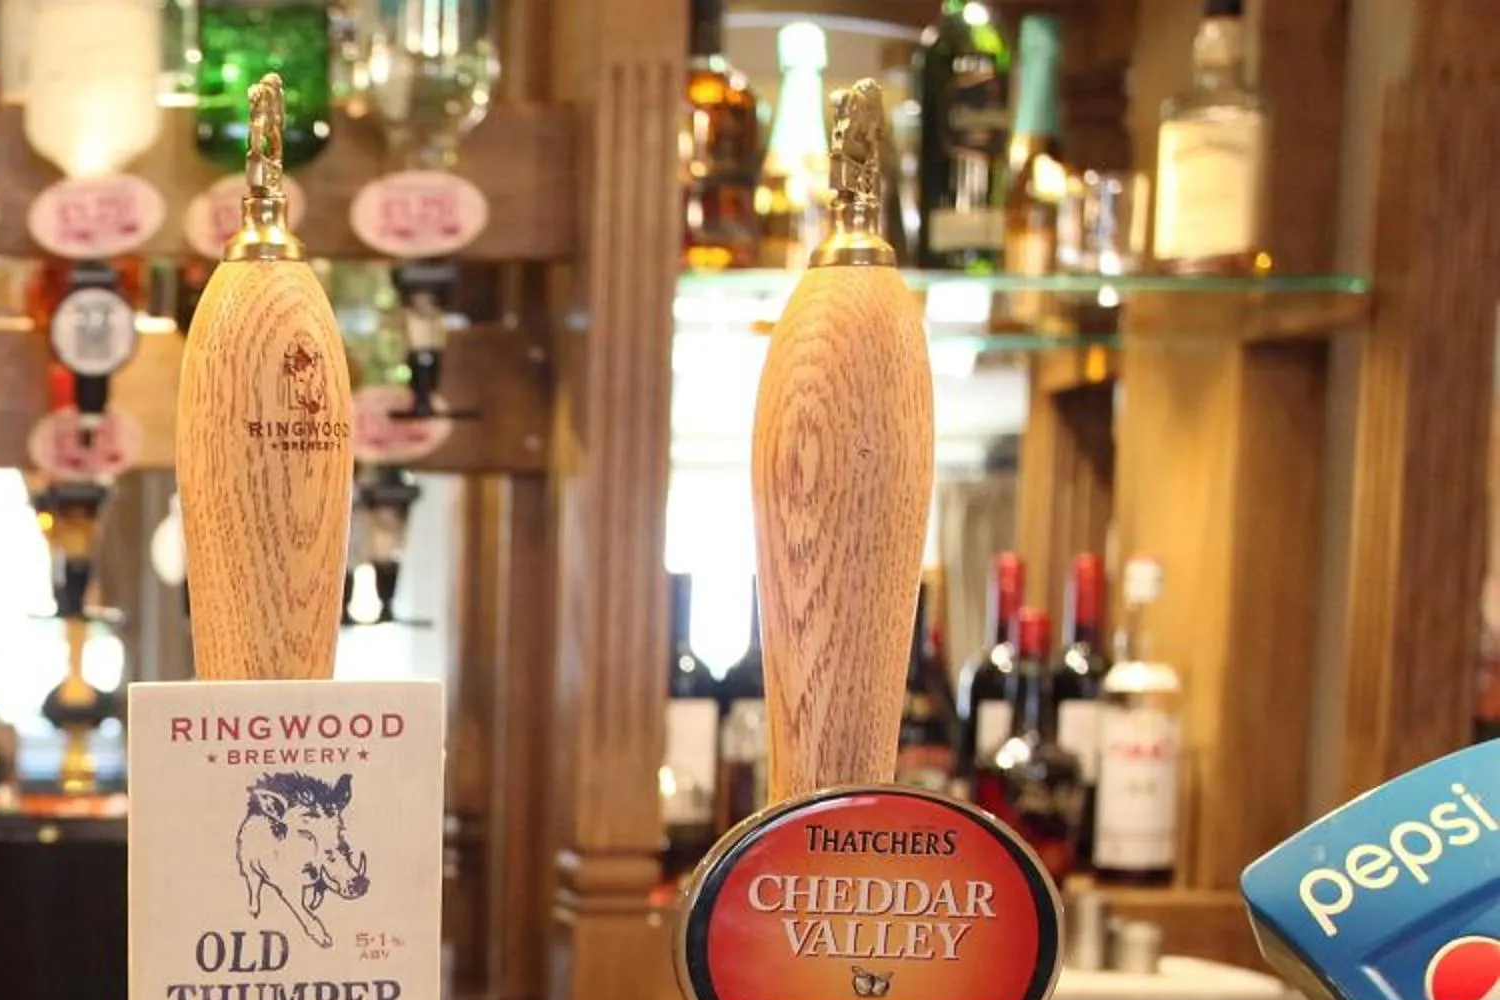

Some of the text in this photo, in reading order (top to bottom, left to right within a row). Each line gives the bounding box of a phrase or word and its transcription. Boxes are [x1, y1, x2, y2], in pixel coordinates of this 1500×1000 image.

[170, 713, 405, 741] RINGWOOD
[227, 748, 350, 765] BREWERY
[805, 824, 957, 855] THATCHERS
[1299, 783, 1498, 937] pepsi
[748, 874, 996, 918] CHEDDAR
[195, 931, 289, 972] OLD
[782, 917, 972, 960] VALLEY
